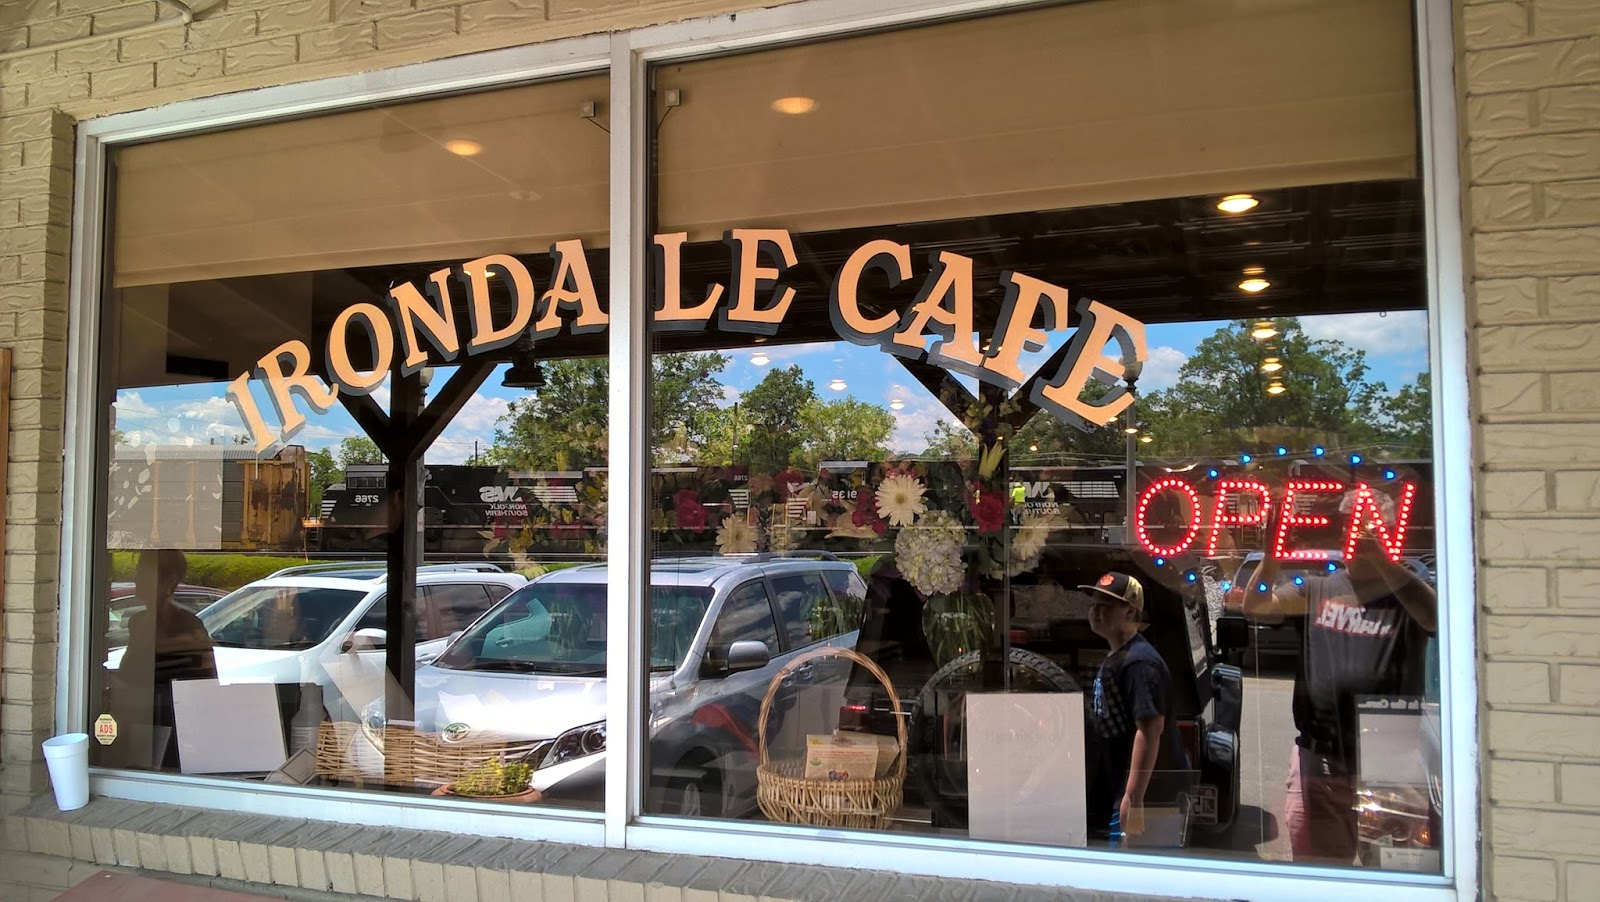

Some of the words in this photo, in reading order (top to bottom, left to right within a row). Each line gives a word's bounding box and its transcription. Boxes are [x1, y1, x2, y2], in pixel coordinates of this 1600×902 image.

[226, 228, 799, 458] IRONDALE
[832, 239, 1148, 430] CAFE
[1136, 477, 1417, 562] OPEN
[99, 724, 113, 734] ADS
